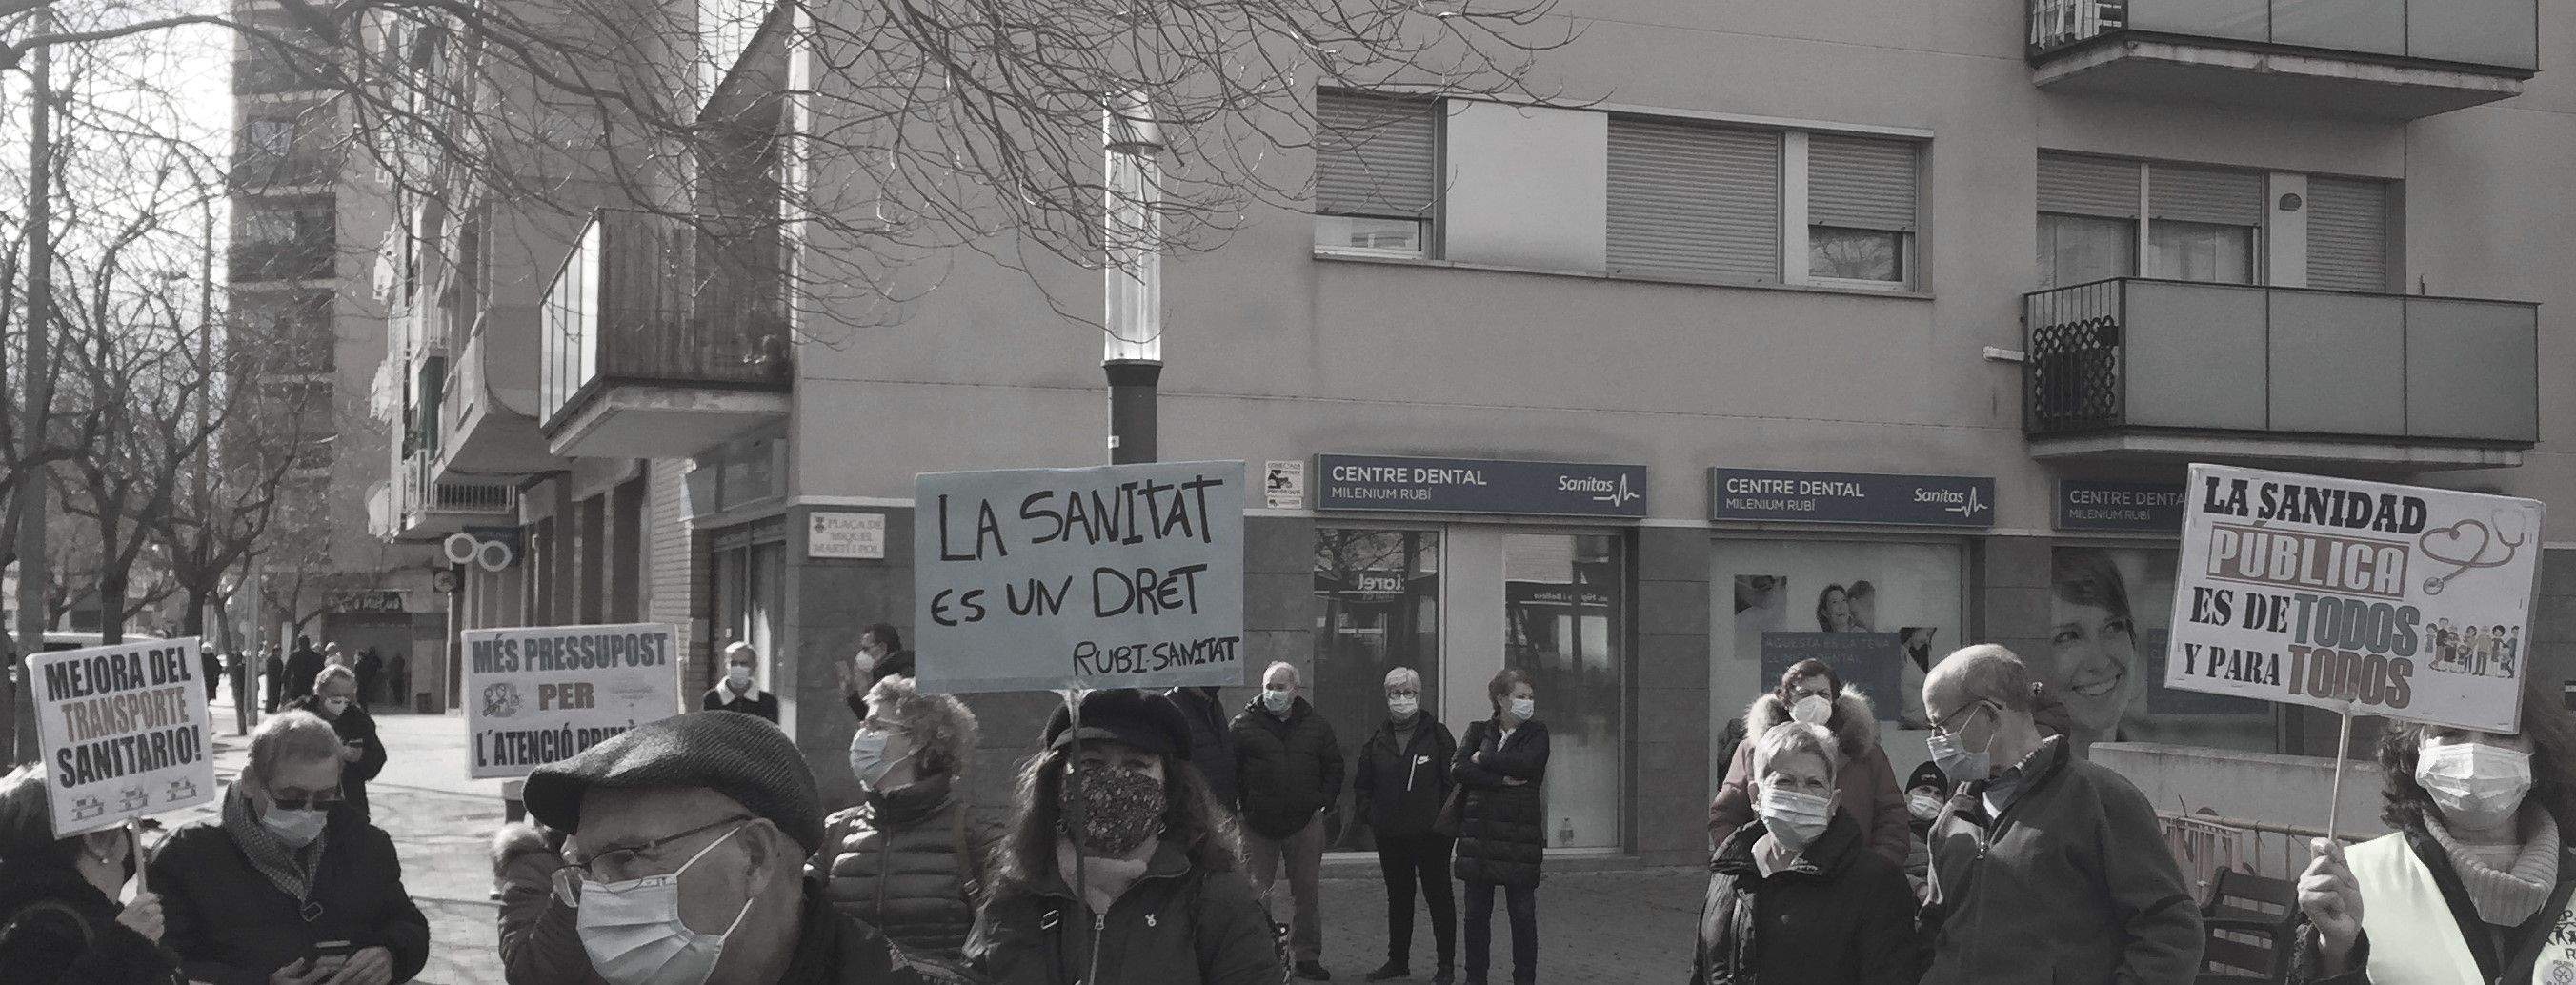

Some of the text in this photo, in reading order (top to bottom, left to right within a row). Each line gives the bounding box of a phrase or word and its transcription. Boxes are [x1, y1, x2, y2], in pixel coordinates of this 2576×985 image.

[1331, 487, 1432, 501] MILENIUM RUBÍ
[1332, 465, 1487, 486] CENTRE DENTAL
[1558, 474, 1614, 492] Sanitas
[1726, 478, 1864, 498] CENTRE DENTAL
[1913, 487, 1965, 503] Sanitas
[938, 474, 1224, 561] LA SANITAT
[1726, 498, 1816, 512] MILENIUM RUBÍ
[2069, 490, 2185, 505] CENTRE DENTA
[2069, 509, 2123, 520] MILENIUM
[2203, 476, 2428, 535] LA SANIDAD
[2207, 521, 2406, 595] PÚBLICA
[930, 563, 1208, 627] ES UN DRET
[2189, 586, 2422, 657] ES DE TODOS
[44, 646, 191, 702] MEJORA DEL
[473, 633, 668, 674] MÉS PRESSUPOST
[2184, 642, 2202, 675] Y
[2206, 646, 2281, 686] PARA
[2288, 644, 2414, 709] TODOS
[60, 686, 191, 743] TRANSPORTE
[538, 682, 595, 712] PER
[56, 724, 202, 789] SANITARIO!
